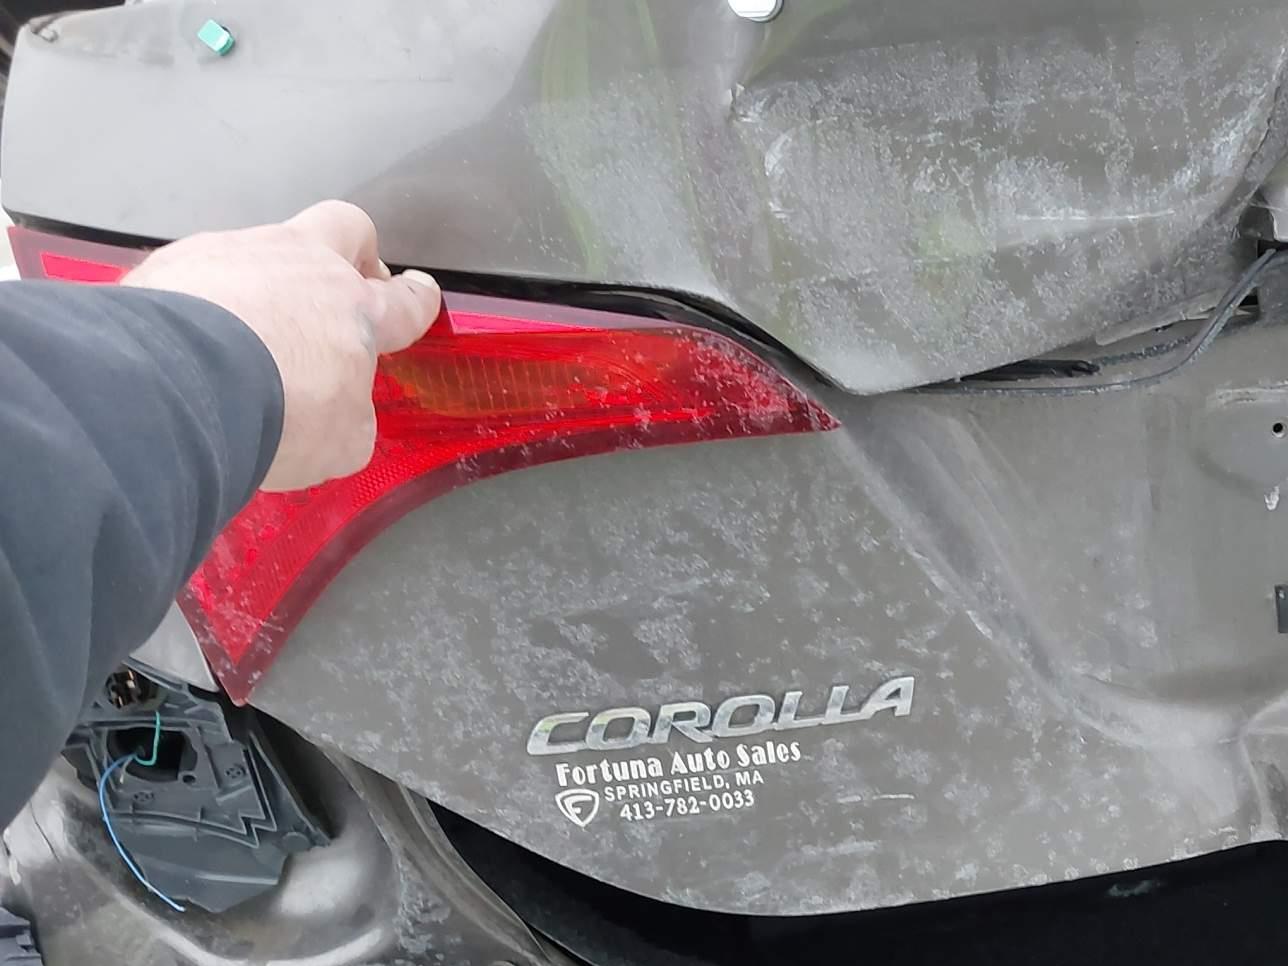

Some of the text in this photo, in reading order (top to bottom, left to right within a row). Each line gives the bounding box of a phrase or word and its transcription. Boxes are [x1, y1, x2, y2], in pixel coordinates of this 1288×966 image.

[527, 675, 915, 756] COROLLA
[555, 740, 801, 787] Fortuna Auto Sales
[604, 770, 764, 802] SPRINGFIELD, MA
[619, 790, 755, 822] 413-782-0033
